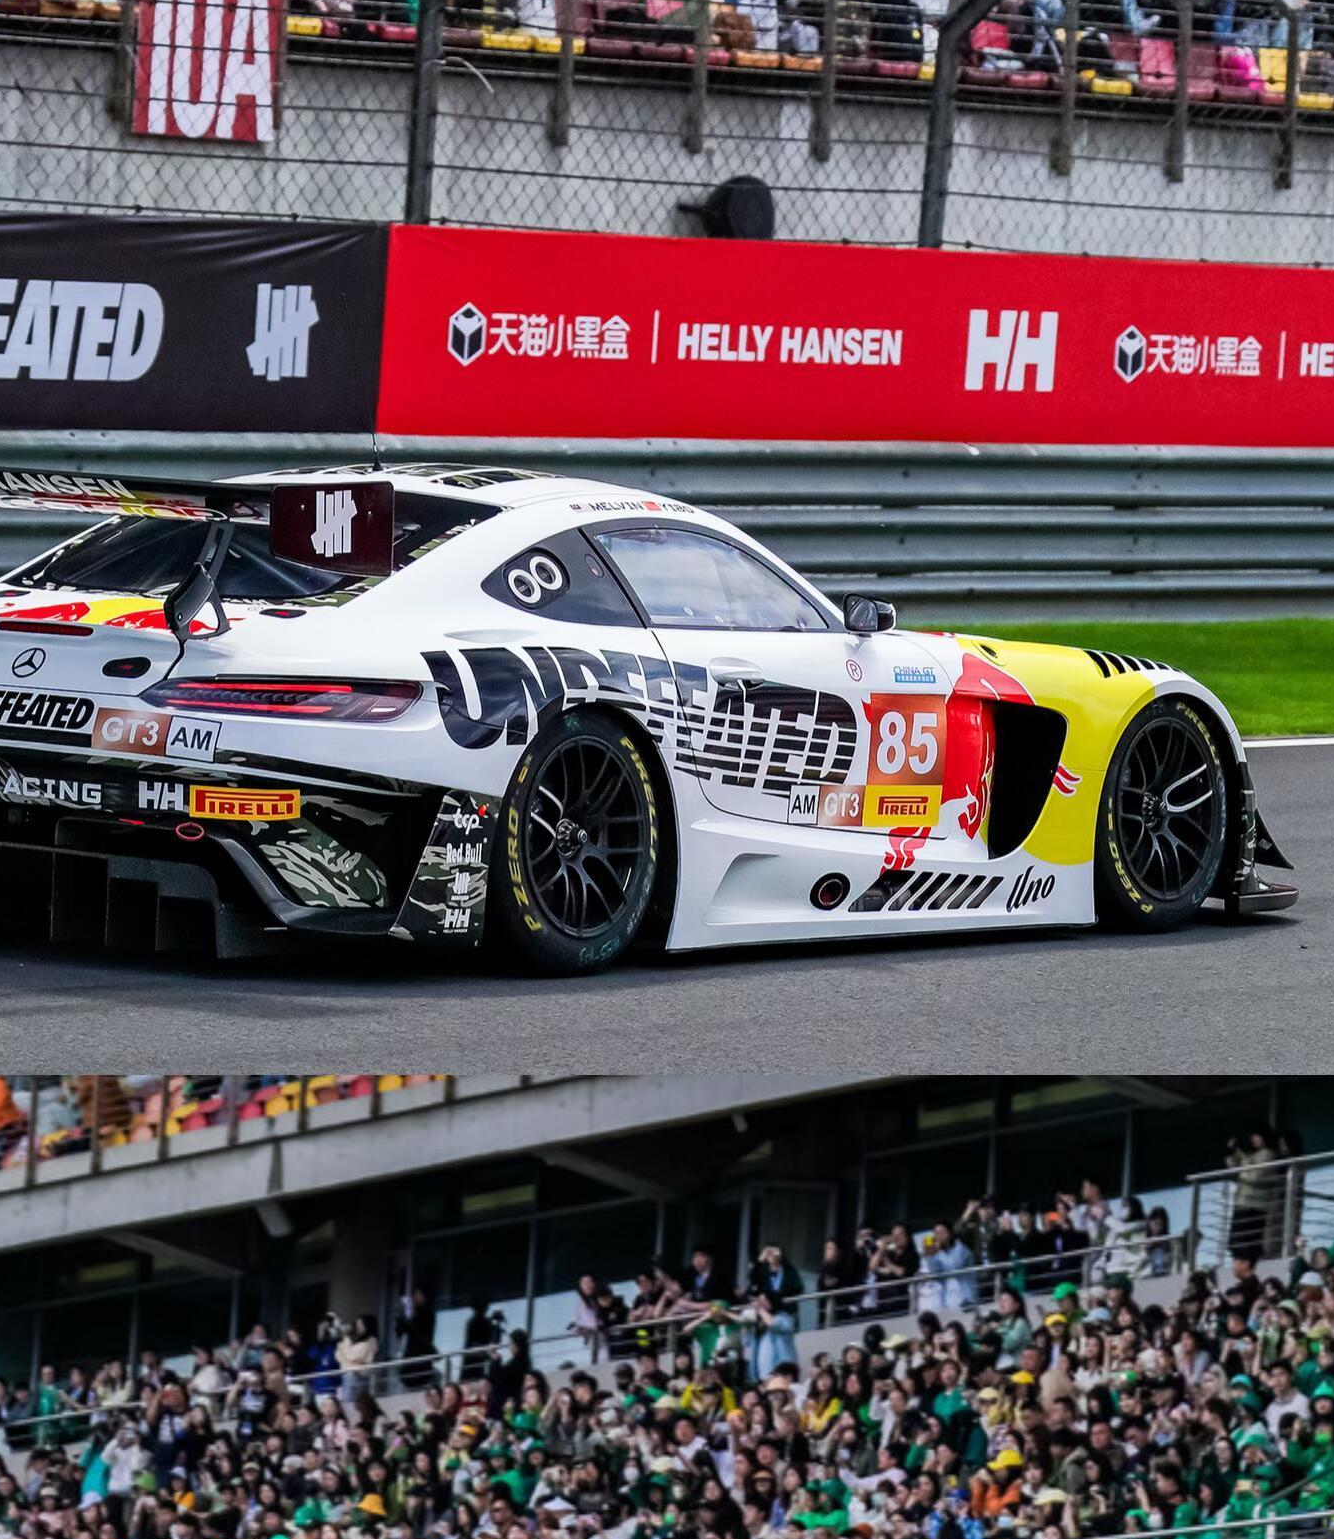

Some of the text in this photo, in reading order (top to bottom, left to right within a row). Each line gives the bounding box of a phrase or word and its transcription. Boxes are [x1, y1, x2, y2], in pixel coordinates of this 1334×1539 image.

[488, 311, 901, 366] 天猫小黑盒 HELLY HANSEN
[1147, 332, 1262, 376] 天猫小黑盒
[588, 501, 644, 511] MELVIN
[101, 716, 159, 746] GT3
[172, 726, 212, 751] AM
[876, 710, 938, 774] 85
[194, 790, 296, 816] PIRELLI
[791, 794, 816, 814] AM
[824, 793, 859, 818] GT3
[878, 796, 928, 815] PIRELLI
[447, 843, 482, 863] Red Bull
